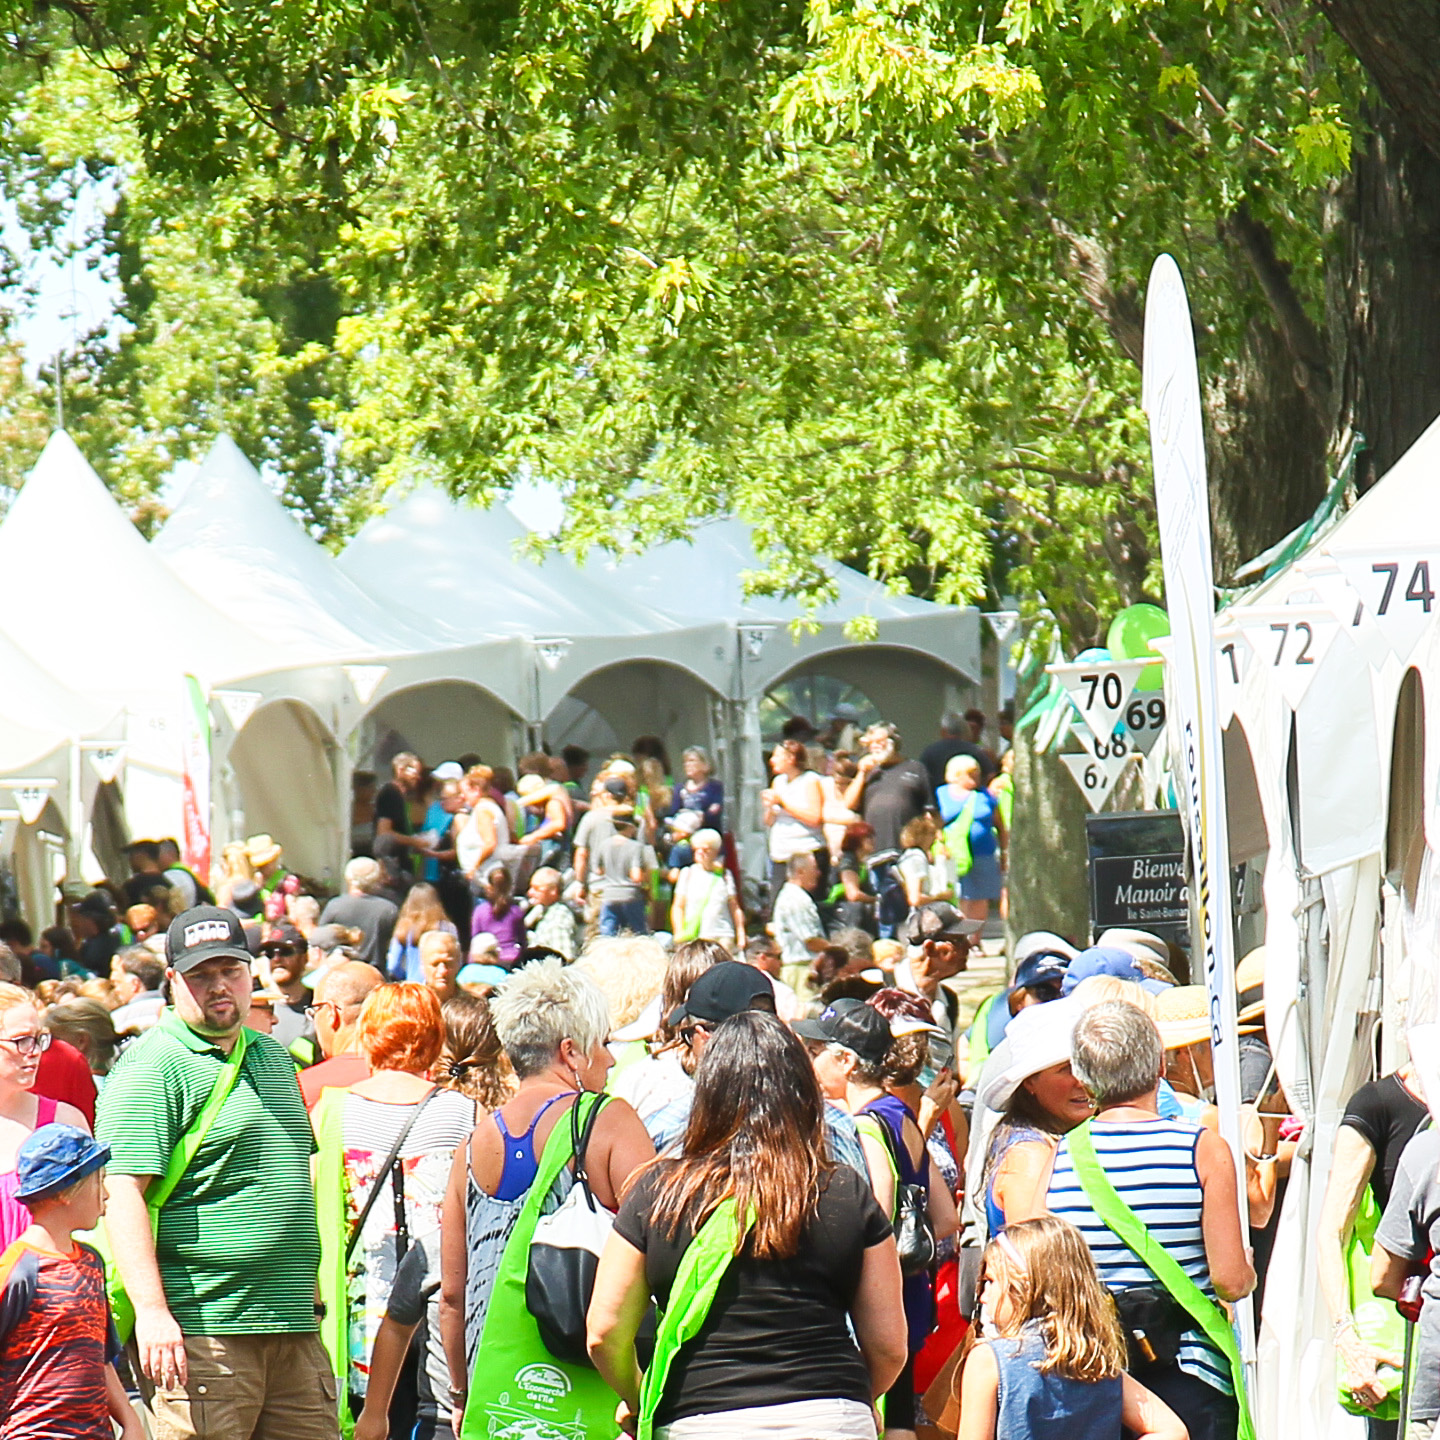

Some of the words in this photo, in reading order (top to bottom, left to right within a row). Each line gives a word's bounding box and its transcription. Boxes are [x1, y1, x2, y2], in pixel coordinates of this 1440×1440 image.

[1371, 560, 1436, 616] 74
[1270, 621, 1315, 667] 72
[1221, 643, 1239, 684] 1
[1080, 672, 1122, 711] 70
[1126, 698, 1167, 731] 69
[1132, 858, 1185, 880] Bienve
[1114, 881, 1177, 905] Manoir
[1139, 906, 1188, 919] Saint-Bernar
[184, 920, 231, 949] KPMG
